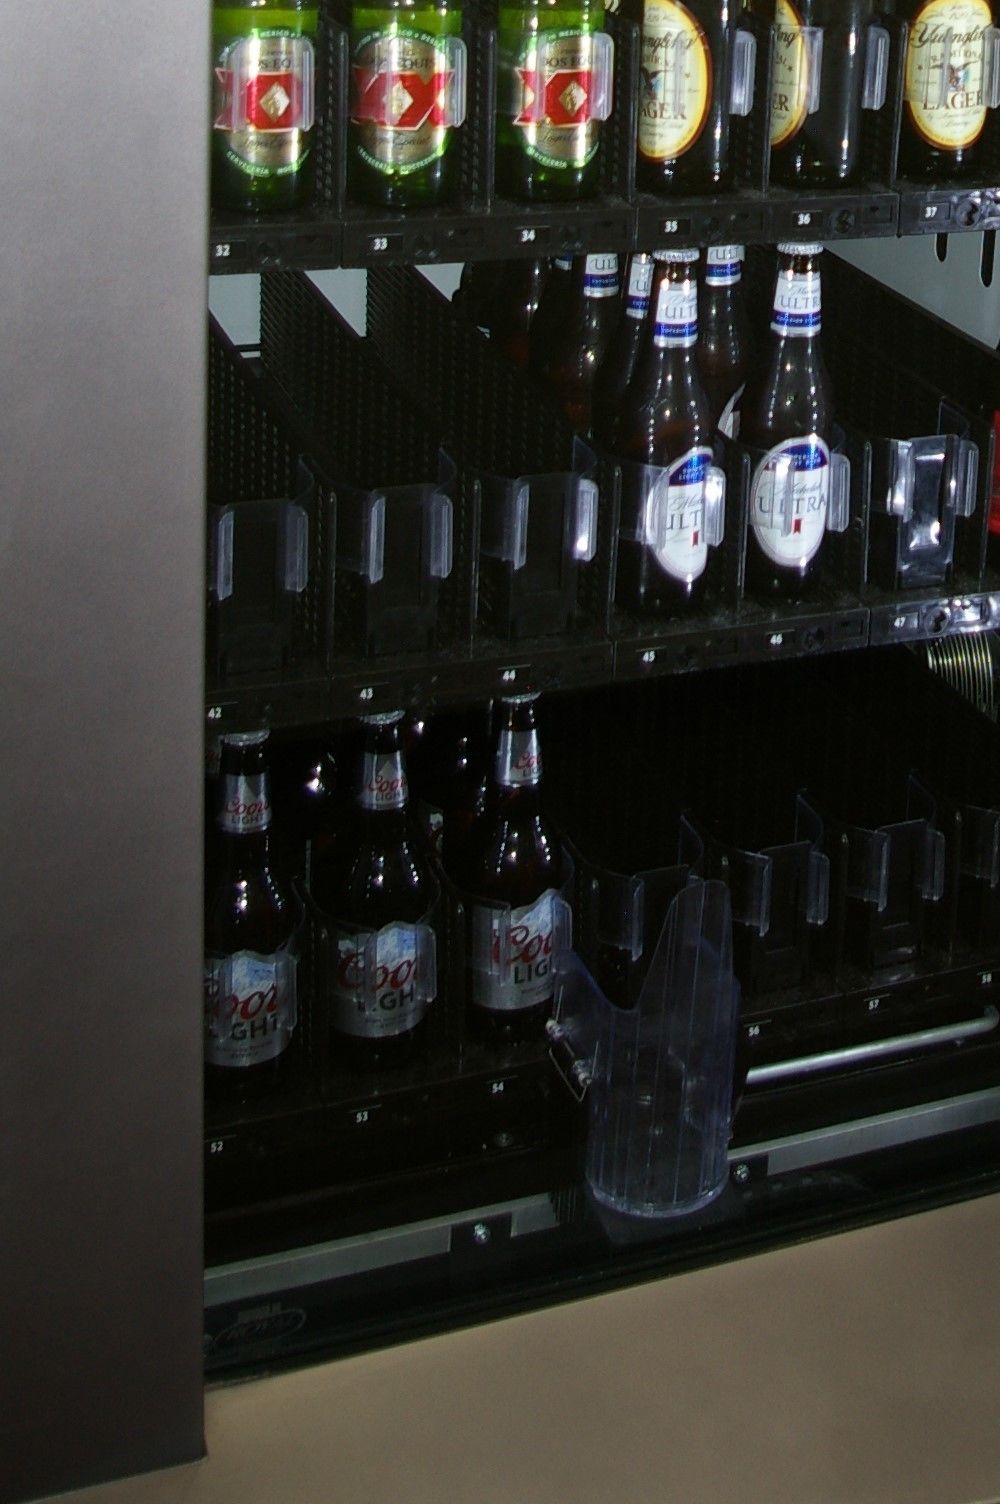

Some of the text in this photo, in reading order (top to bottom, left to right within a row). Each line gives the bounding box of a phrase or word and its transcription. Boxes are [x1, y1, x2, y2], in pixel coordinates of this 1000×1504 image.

[925, 206, 938, 218] 37
[797, 213, 811, 226] 36
[664, 220, 678, 233] 35
[521, 229, 536, 242] 34
[215, 244, 230, 257] 32
[373, 237, 388, 251] 33
[893, 616, 906, 628] 47
[770, 633, 783, 645] 46
[642, 650, 656, 663] 45
[502, 669, 516, 681] 44
[359, 687, 374, 700] 43
[207, 706, 222, 719] 42
